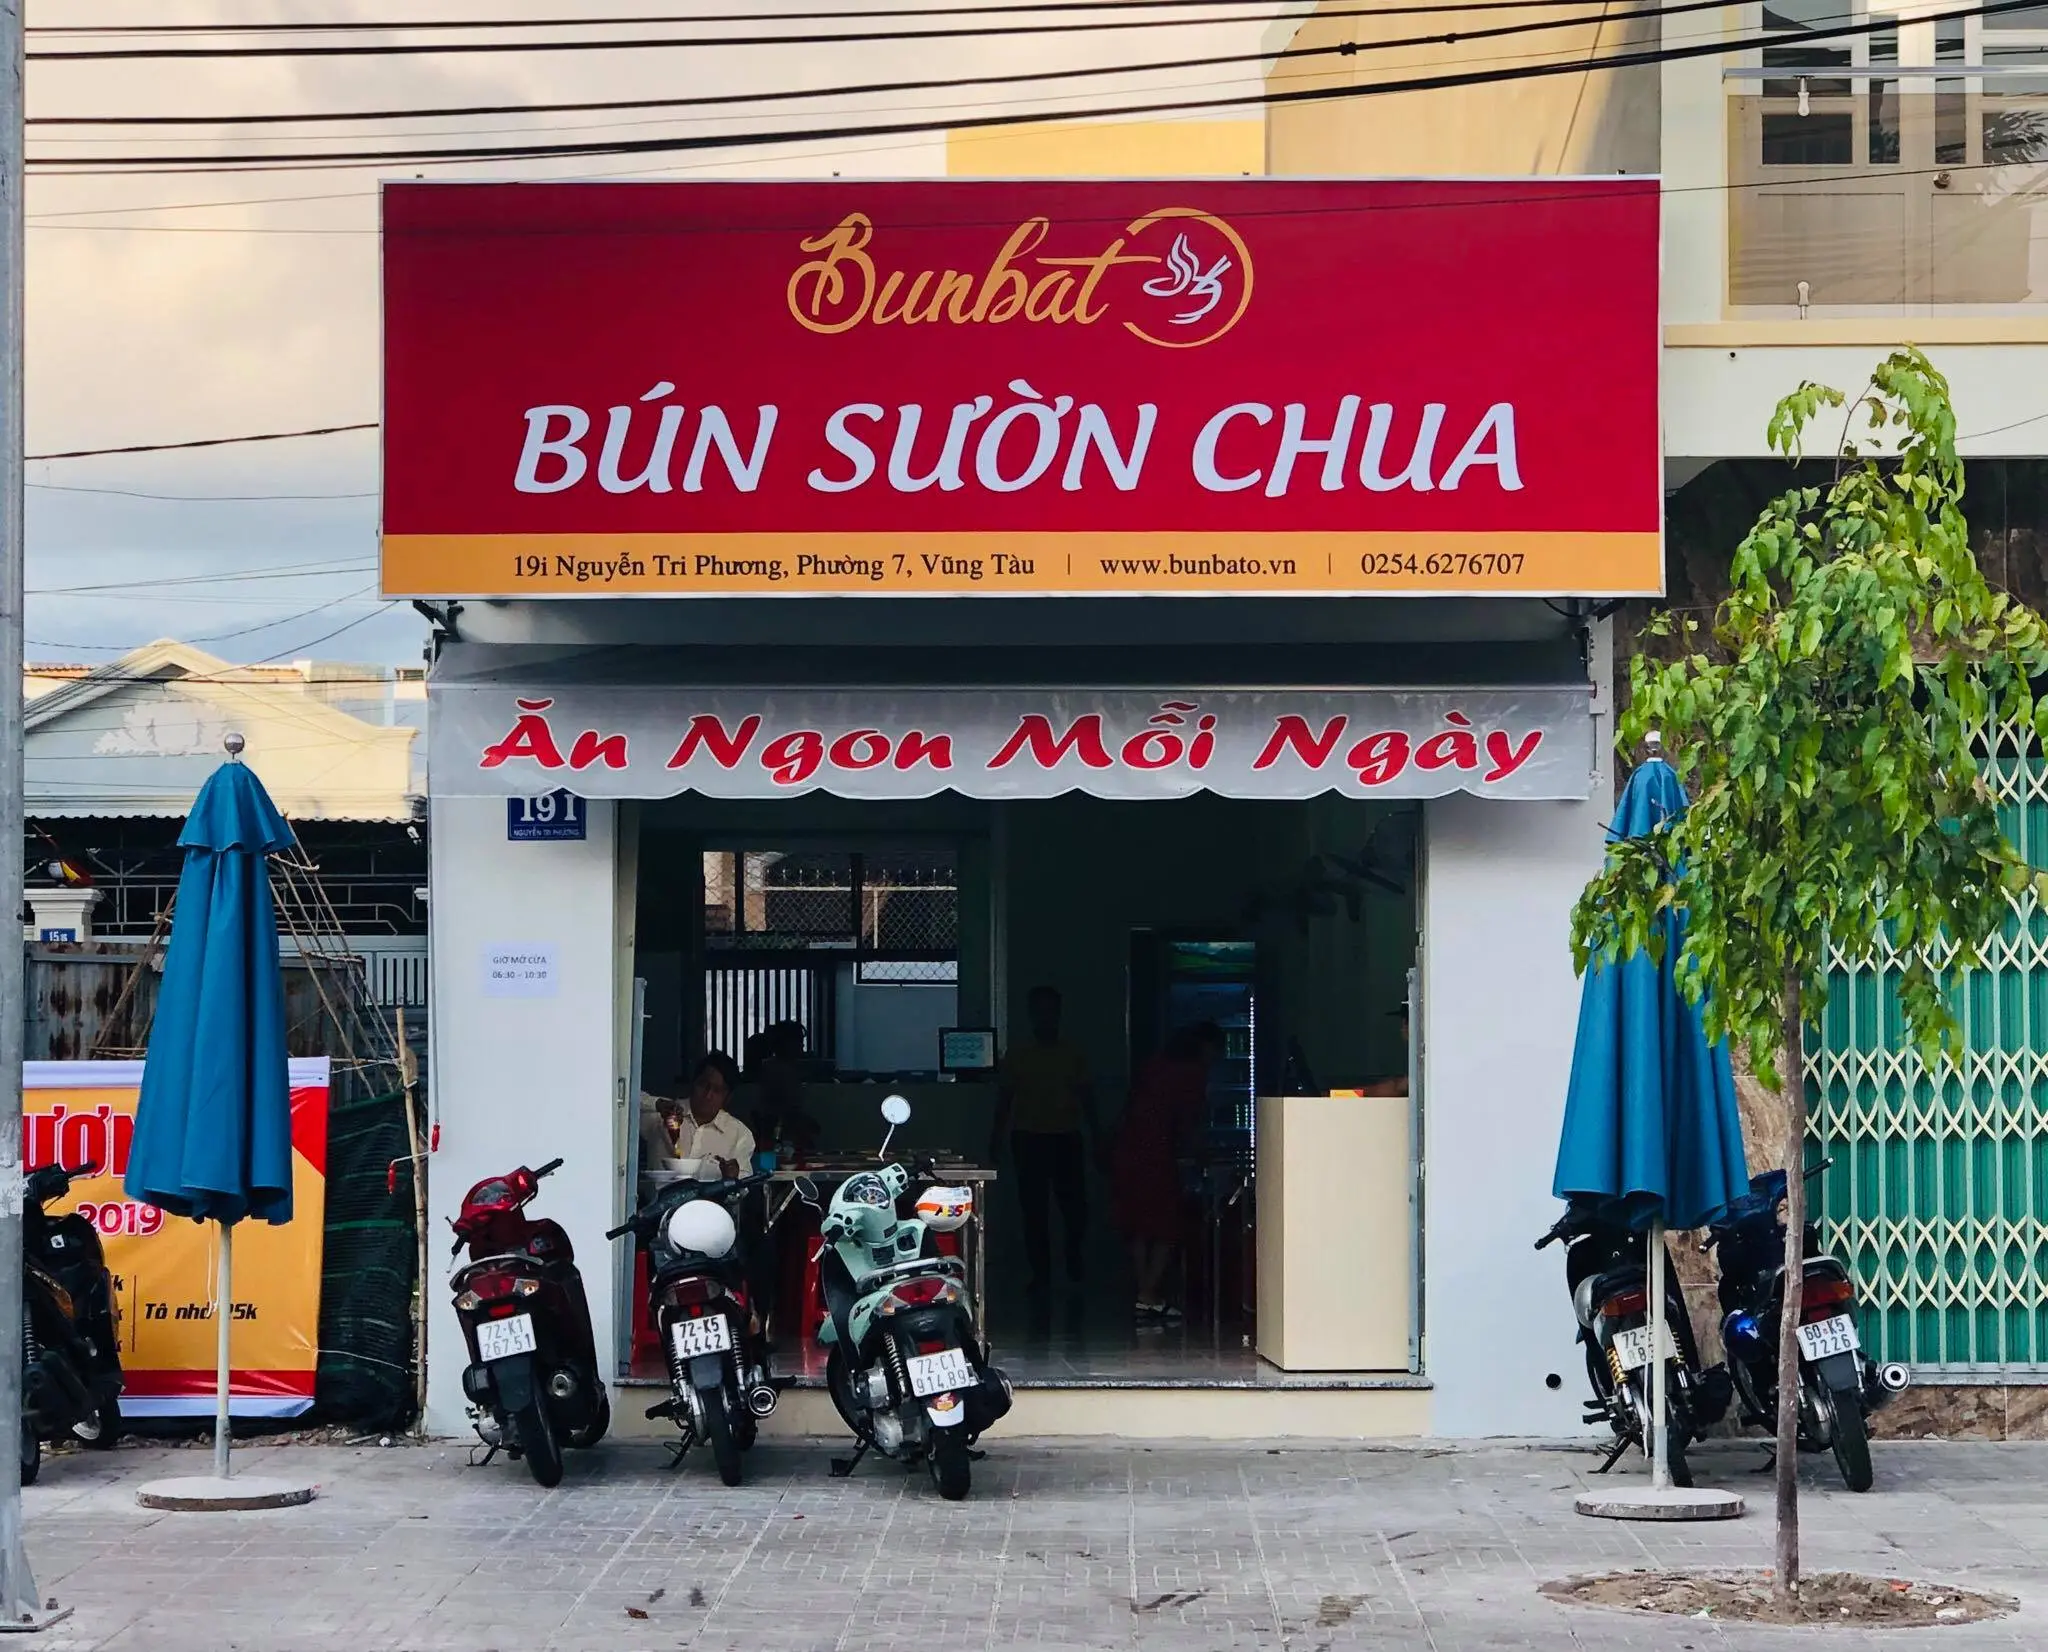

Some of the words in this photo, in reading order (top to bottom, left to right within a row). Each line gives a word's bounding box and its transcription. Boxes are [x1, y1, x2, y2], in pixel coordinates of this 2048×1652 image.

[514, 381, 778, 494] BÚN
[807, 379, 1158, 493] SƯỜN
[1192, 394, 1524, 498] CHUA
[514, 555, 549, 577] 19i
[555, 552, 646, 582] Nguyễn
[653, 555, 688, 577] Tri
[695, 555, 789, 581] Phương,
[797, 554, 885, 581] Phường
[892, 554, 913, 579] 7,
[921, 553, 984, 581] Vũng
[991, 553, 1035, 576] Tàu
[1100, 555, 1297, 575] www.bunbato.vn
[1361, 554, 1525, 576] 0254.6276707
[479, 697, 628, 771] Ăn
[666, 713, 954, 786] Ngon
[989, 701, 1217, 771] Mỗi
[1252, 711, 1544, 787] Ngày
[76, 1201, 164, 1237] 2019
[486, 1318, 523, 1340] 72-K1
[680, 1317, 719, 1338] 72-K5
[684, 1333, 723, 1355] 4442
[1810, 1333, 1851, 1357] 7226
